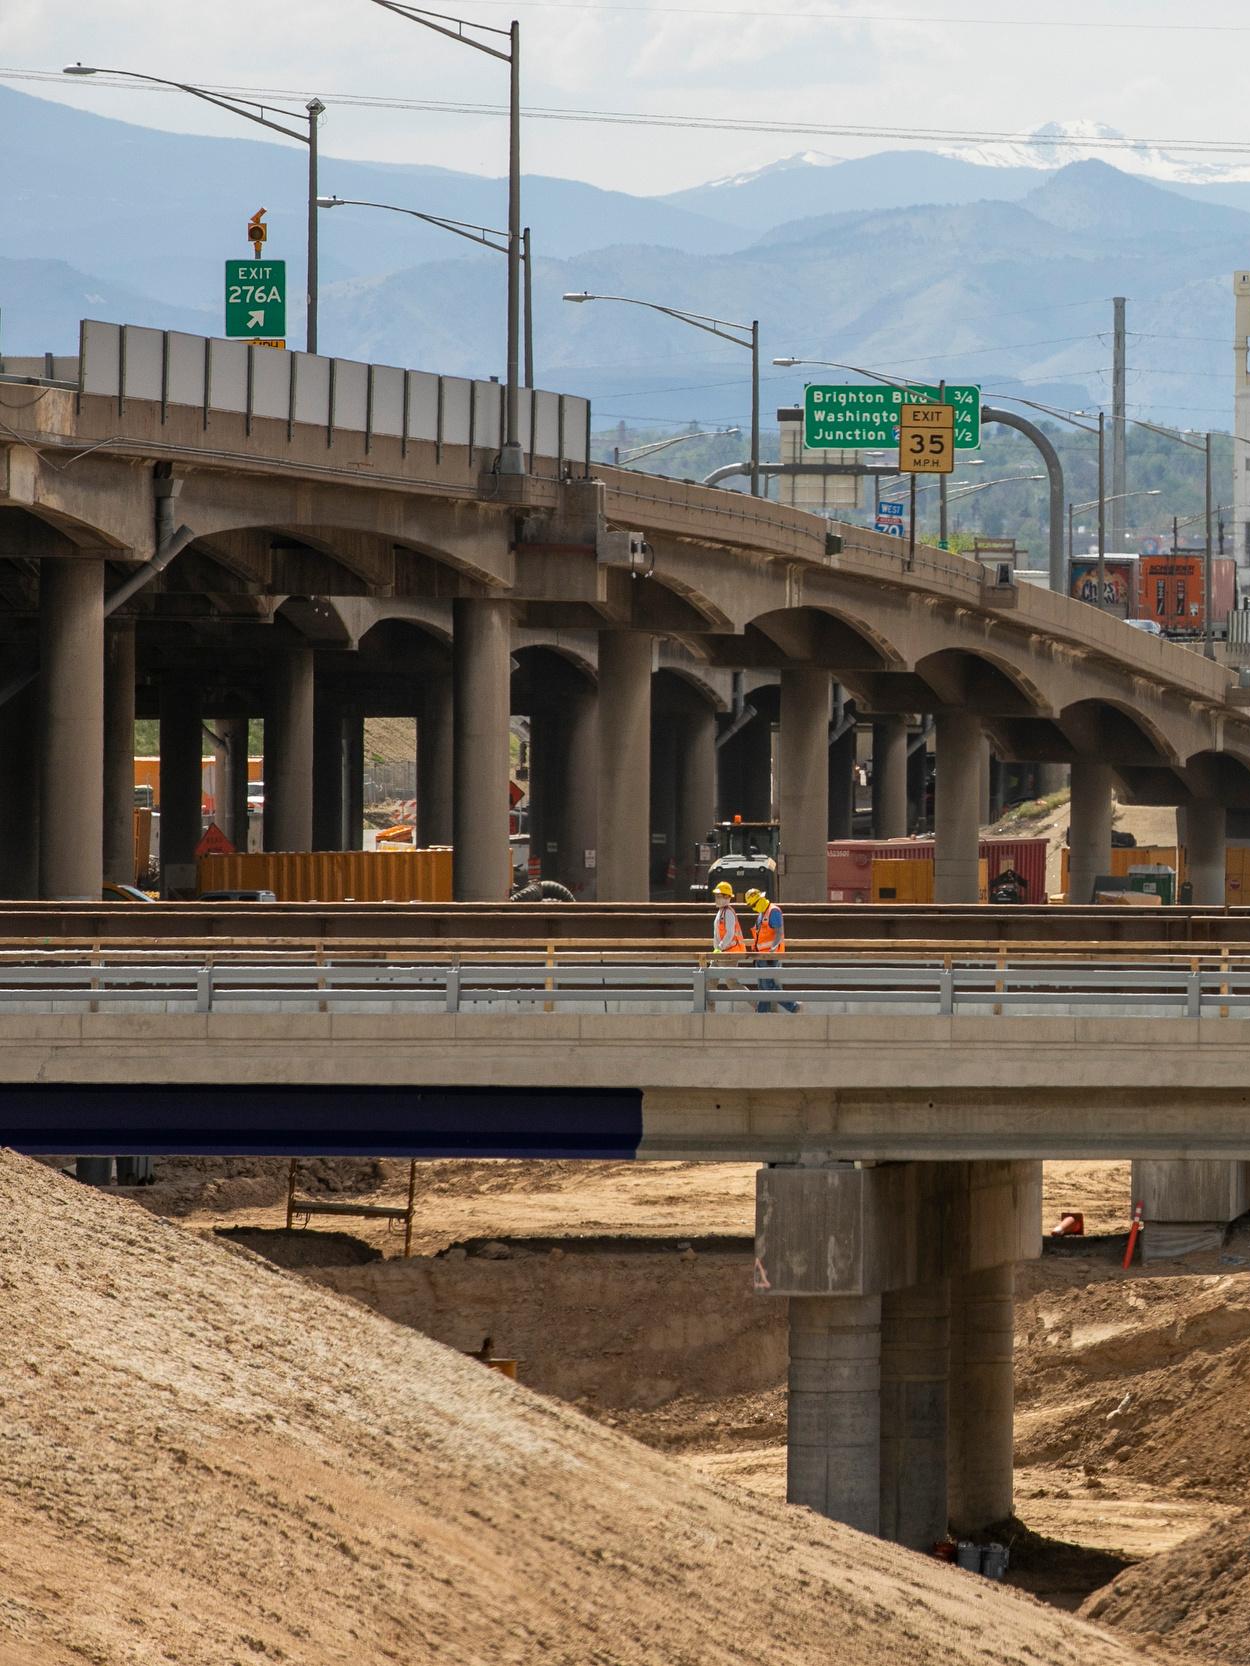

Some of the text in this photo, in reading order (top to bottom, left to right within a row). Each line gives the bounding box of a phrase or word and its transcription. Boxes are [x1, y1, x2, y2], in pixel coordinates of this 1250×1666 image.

[238, 267, 272, 280] EXIT
[228, 285, 282, 304] 276A
[813, 391, 884, 406] Brighton
[954, 391, 974, 404] 3/4
[912, 411, 943, 422] EXIT
[813, 429, 886, 441] Junction
[909, 434, 945, 455] 35
[913, 459, 942, 468] M.P.H.
[881, 503, 900, 514] WEST
[878, 524, 900, 537] 70
